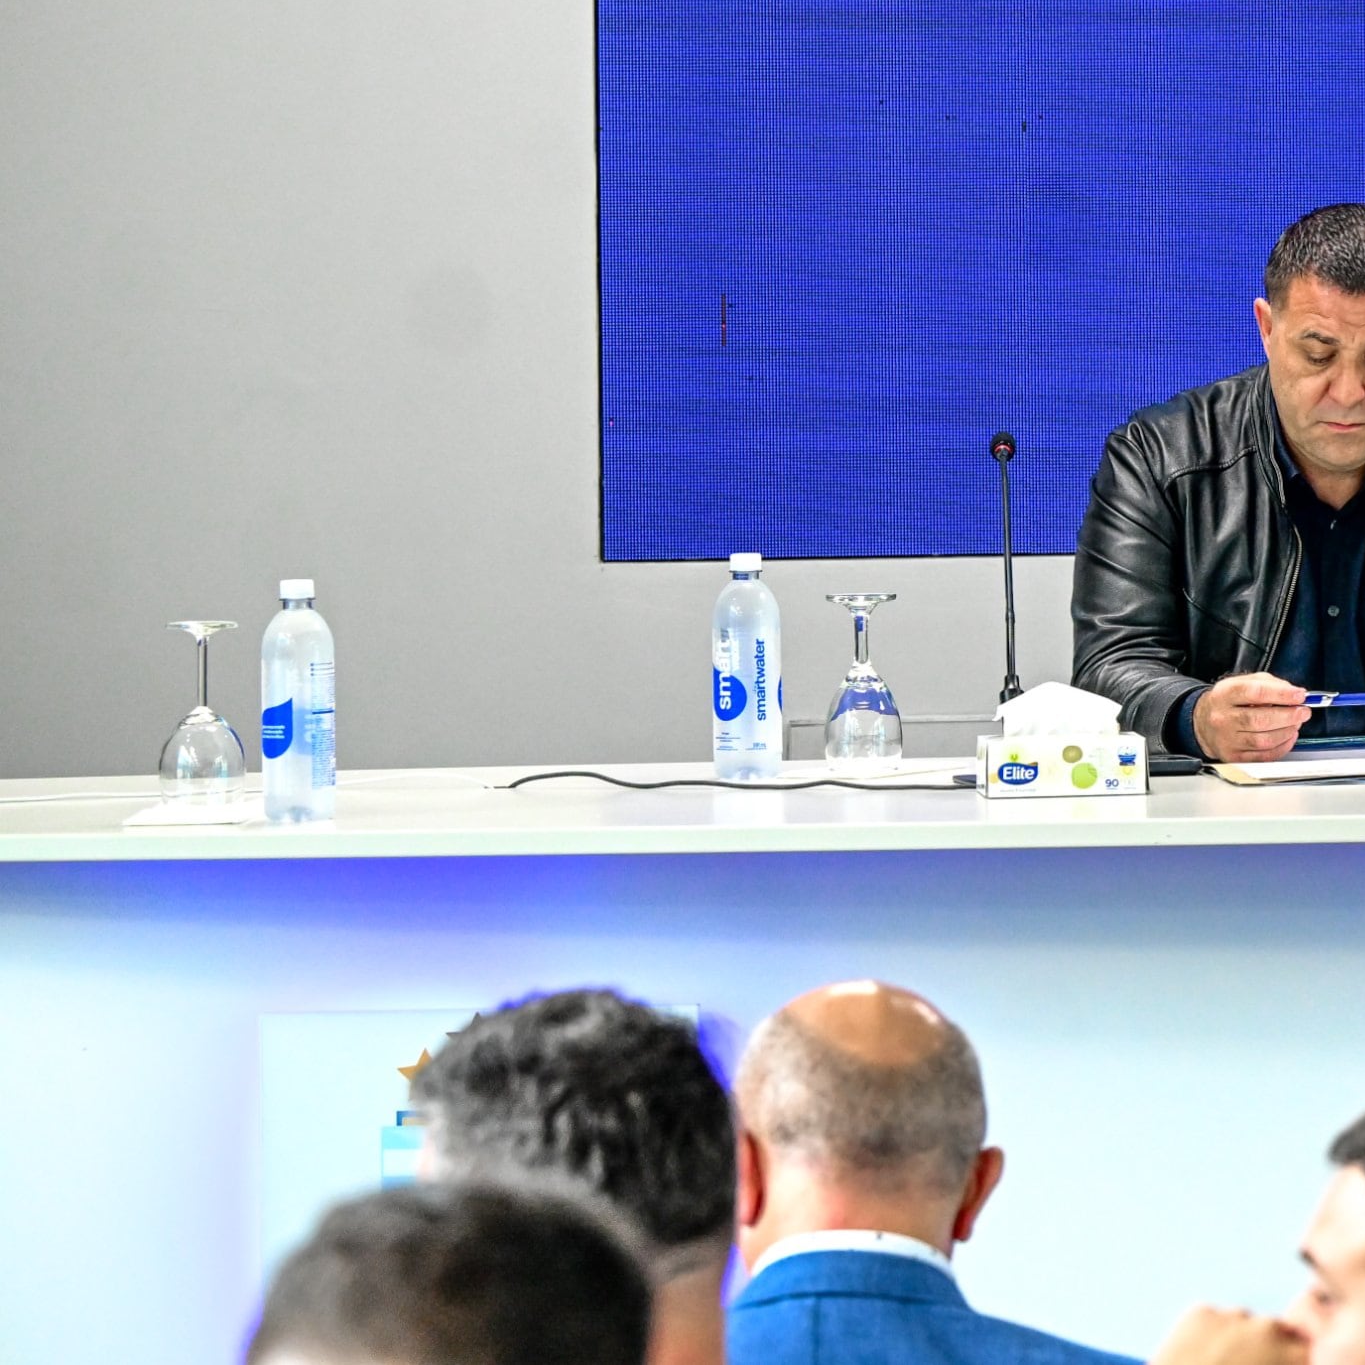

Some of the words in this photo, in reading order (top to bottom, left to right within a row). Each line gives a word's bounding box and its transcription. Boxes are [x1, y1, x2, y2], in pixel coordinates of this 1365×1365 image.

[754, 638, 767, 721] smartwater
[1002, 766, 1036, 781] Elite
[1104, 778, 1120, 788] 90
